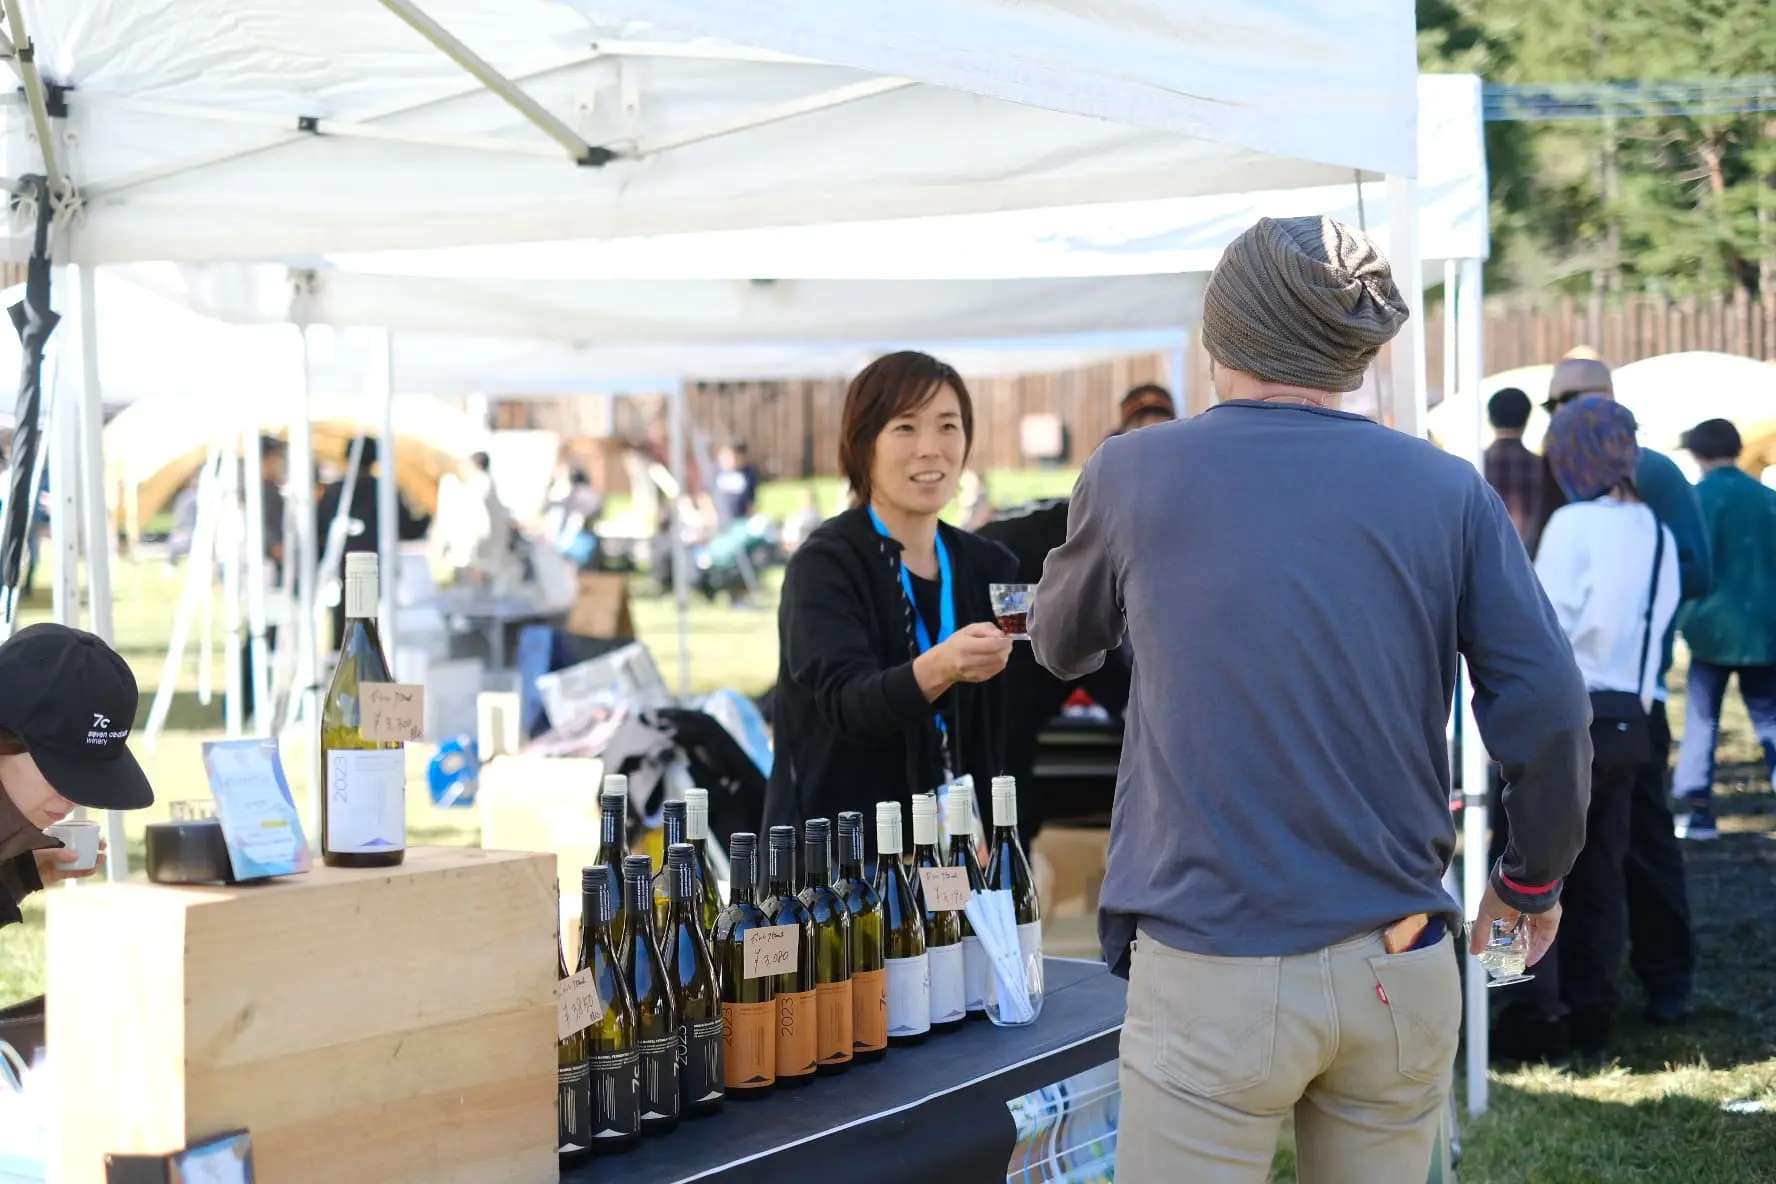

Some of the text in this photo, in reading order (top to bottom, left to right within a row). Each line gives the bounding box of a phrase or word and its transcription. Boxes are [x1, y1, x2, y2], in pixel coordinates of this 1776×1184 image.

[93, 712, 111, 729] 7c
[334, 756, 347, 803] 2023
[781, 997, 793, 1037] 2023
